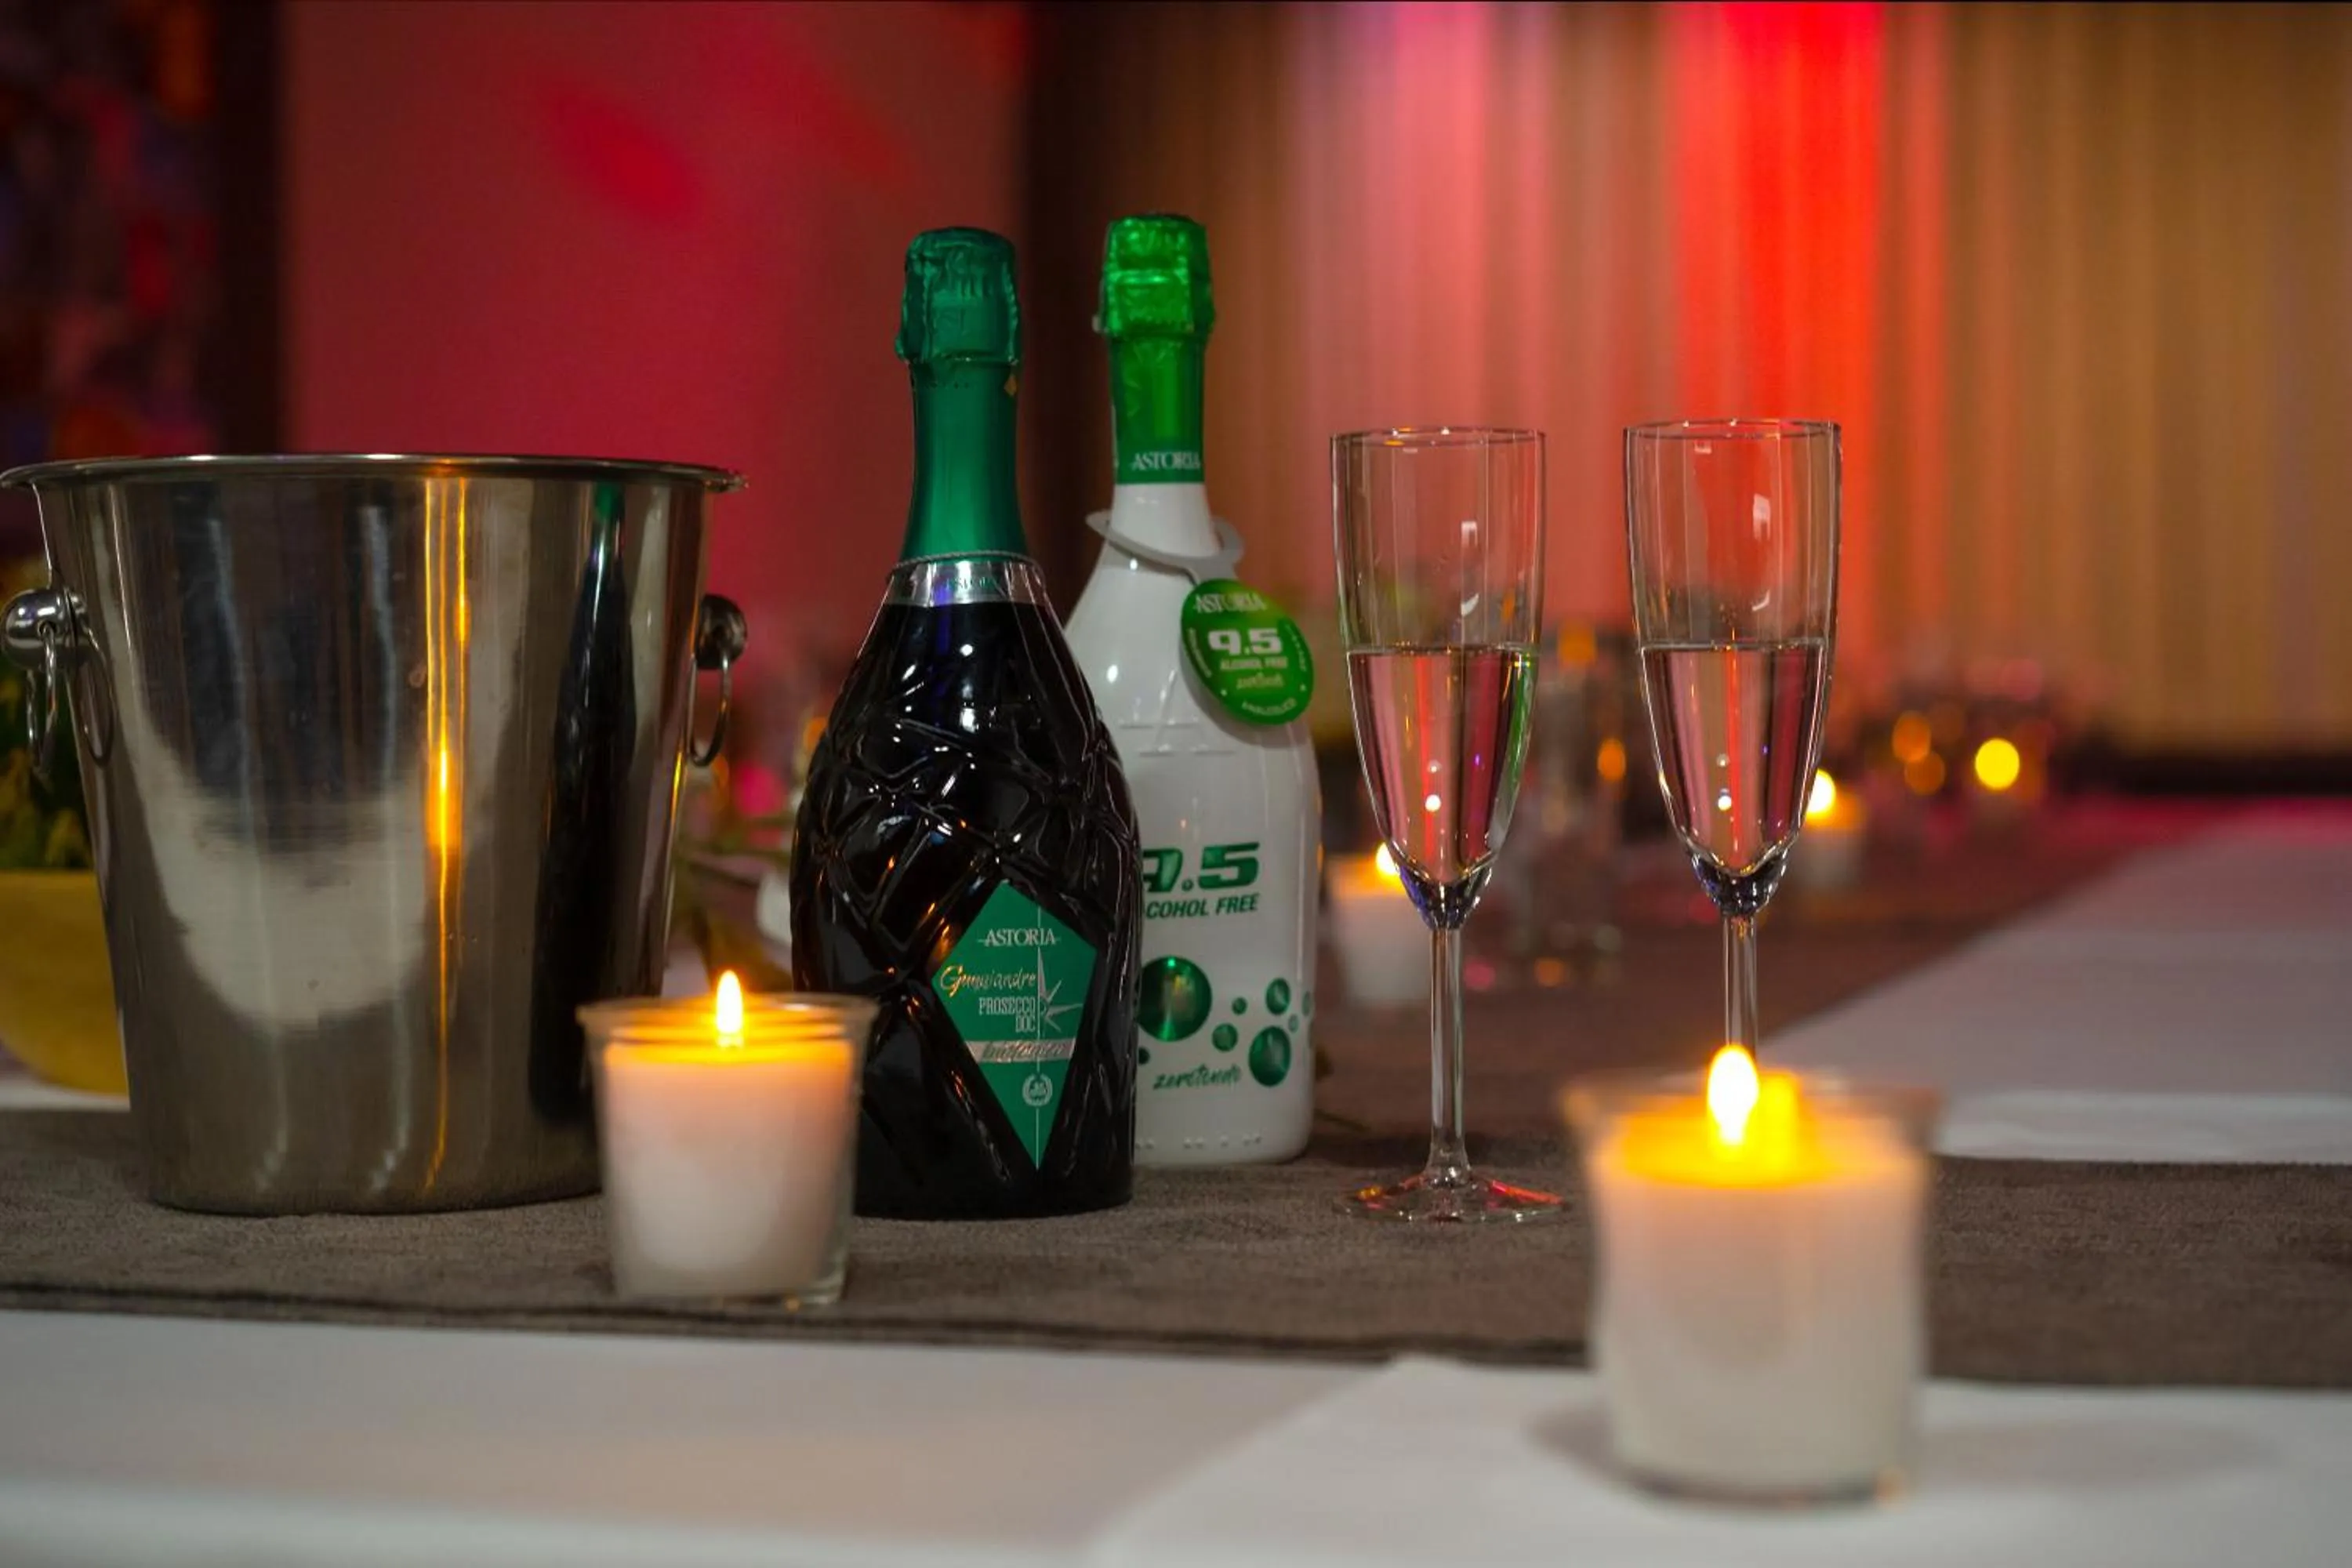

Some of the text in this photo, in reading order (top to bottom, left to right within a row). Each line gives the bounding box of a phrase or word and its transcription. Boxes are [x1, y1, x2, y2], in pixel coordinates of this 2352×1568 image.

[1208, 628, 1282, 655] 9.5
[1146, 894, 1259, 919] COHOL FREE
[984, 928, 1056, 946] ASTORIA
[978, 996, 1036, 1015] PROSECCO
